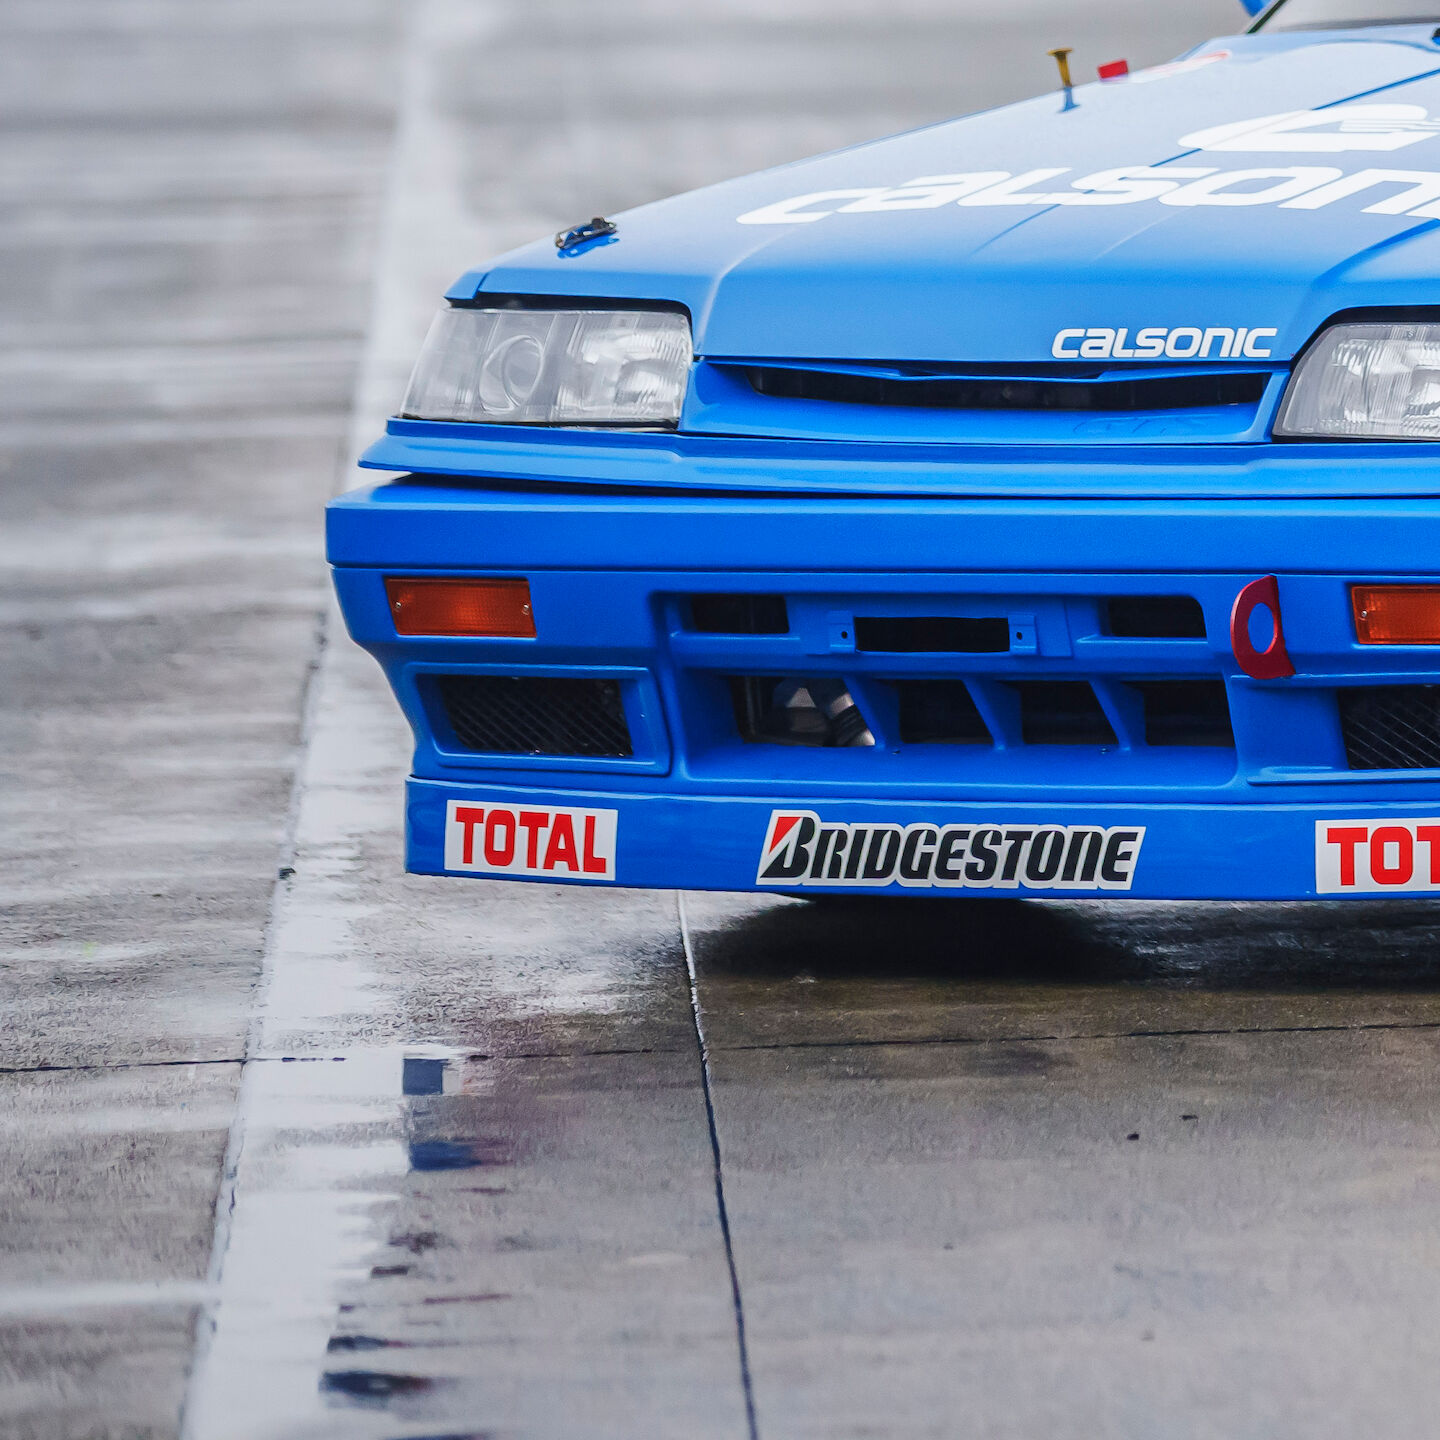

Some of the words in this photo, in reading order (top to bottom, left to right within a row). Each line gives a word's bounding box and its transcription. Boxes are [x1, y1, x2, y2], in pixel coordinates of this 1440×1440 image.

[1050, 326, 1278, 360] CALSONIC
[454, 805, 609, 875] TOTAL
[760, 815, 1139, 883] BRIDGESTONE
